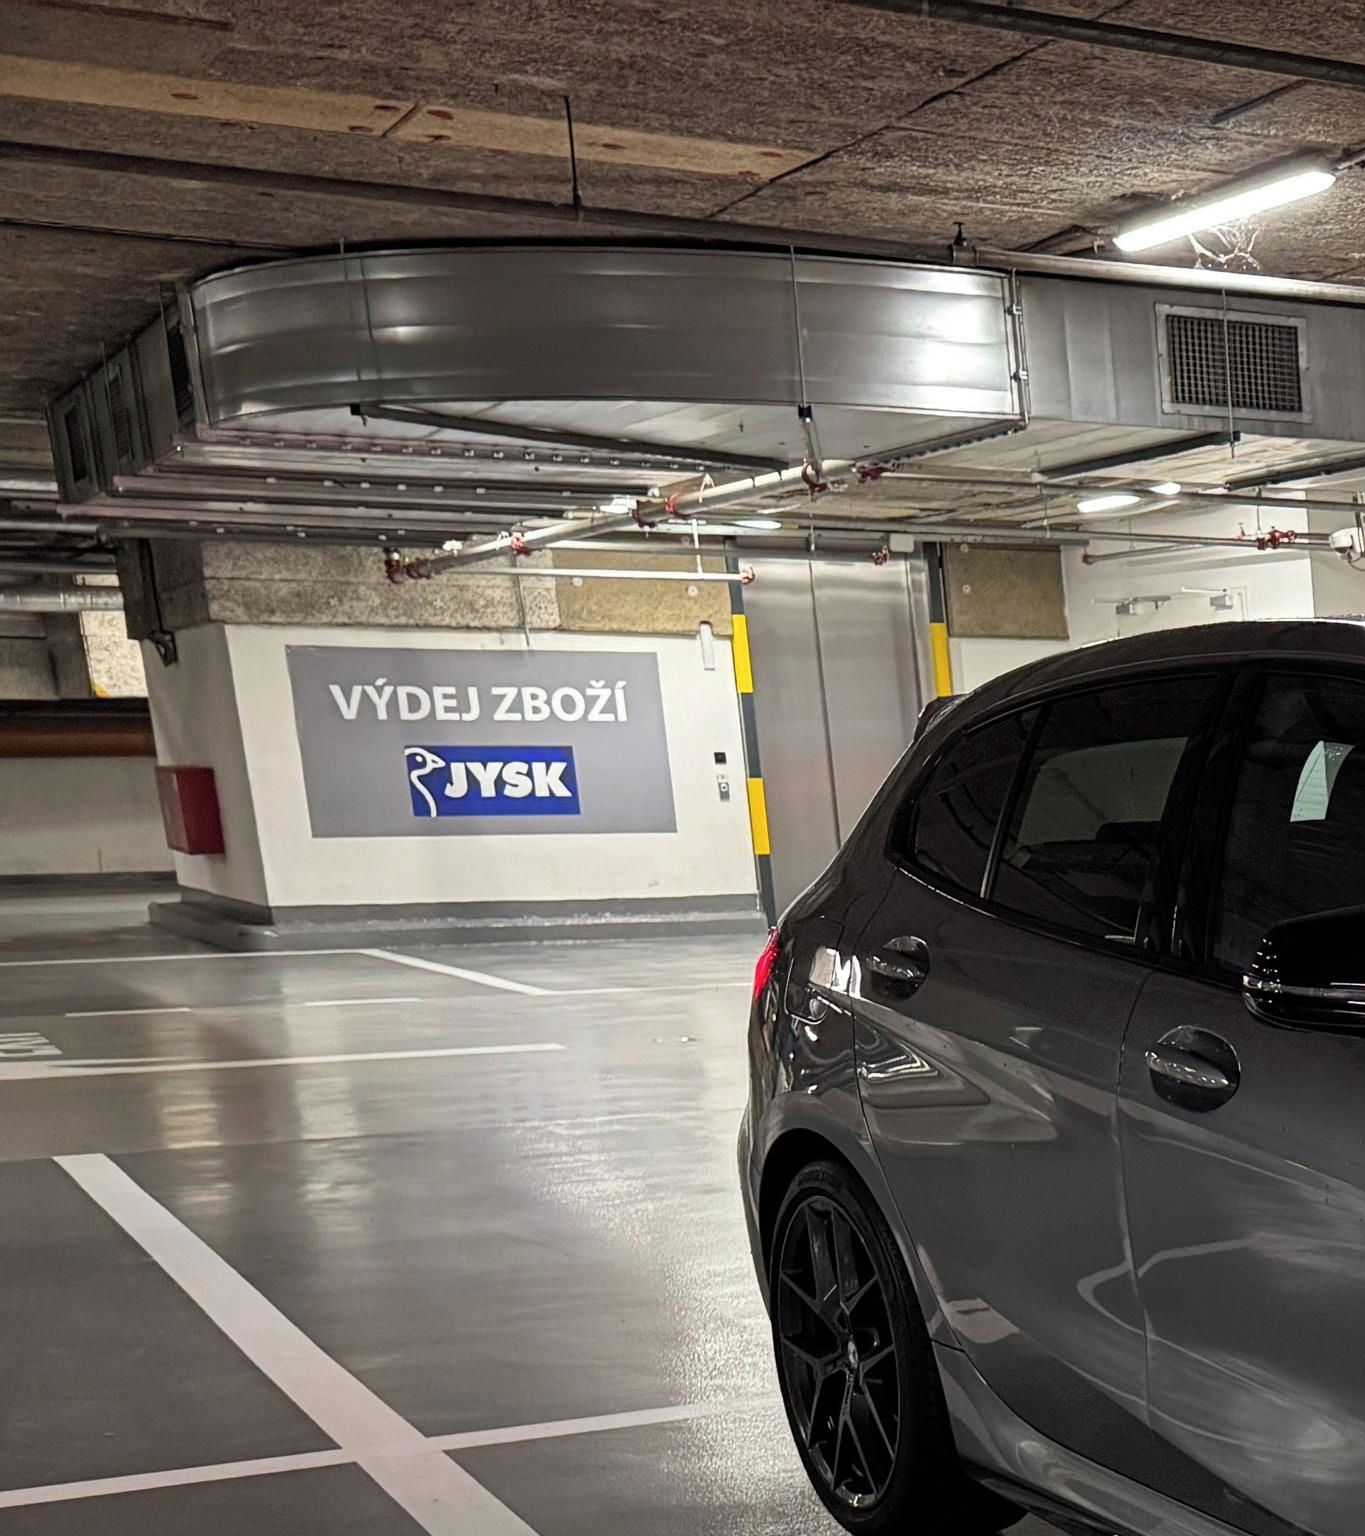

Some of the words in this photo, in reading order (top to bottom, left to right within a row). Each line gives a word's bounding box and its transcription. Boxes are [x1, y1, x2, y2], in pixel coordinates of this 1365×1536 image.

[328, 677, 482, 721] VÝDEJ
[490, 680, 629, 723] ZBOŽÍ
[443, 760, 573, 799] JYSK
